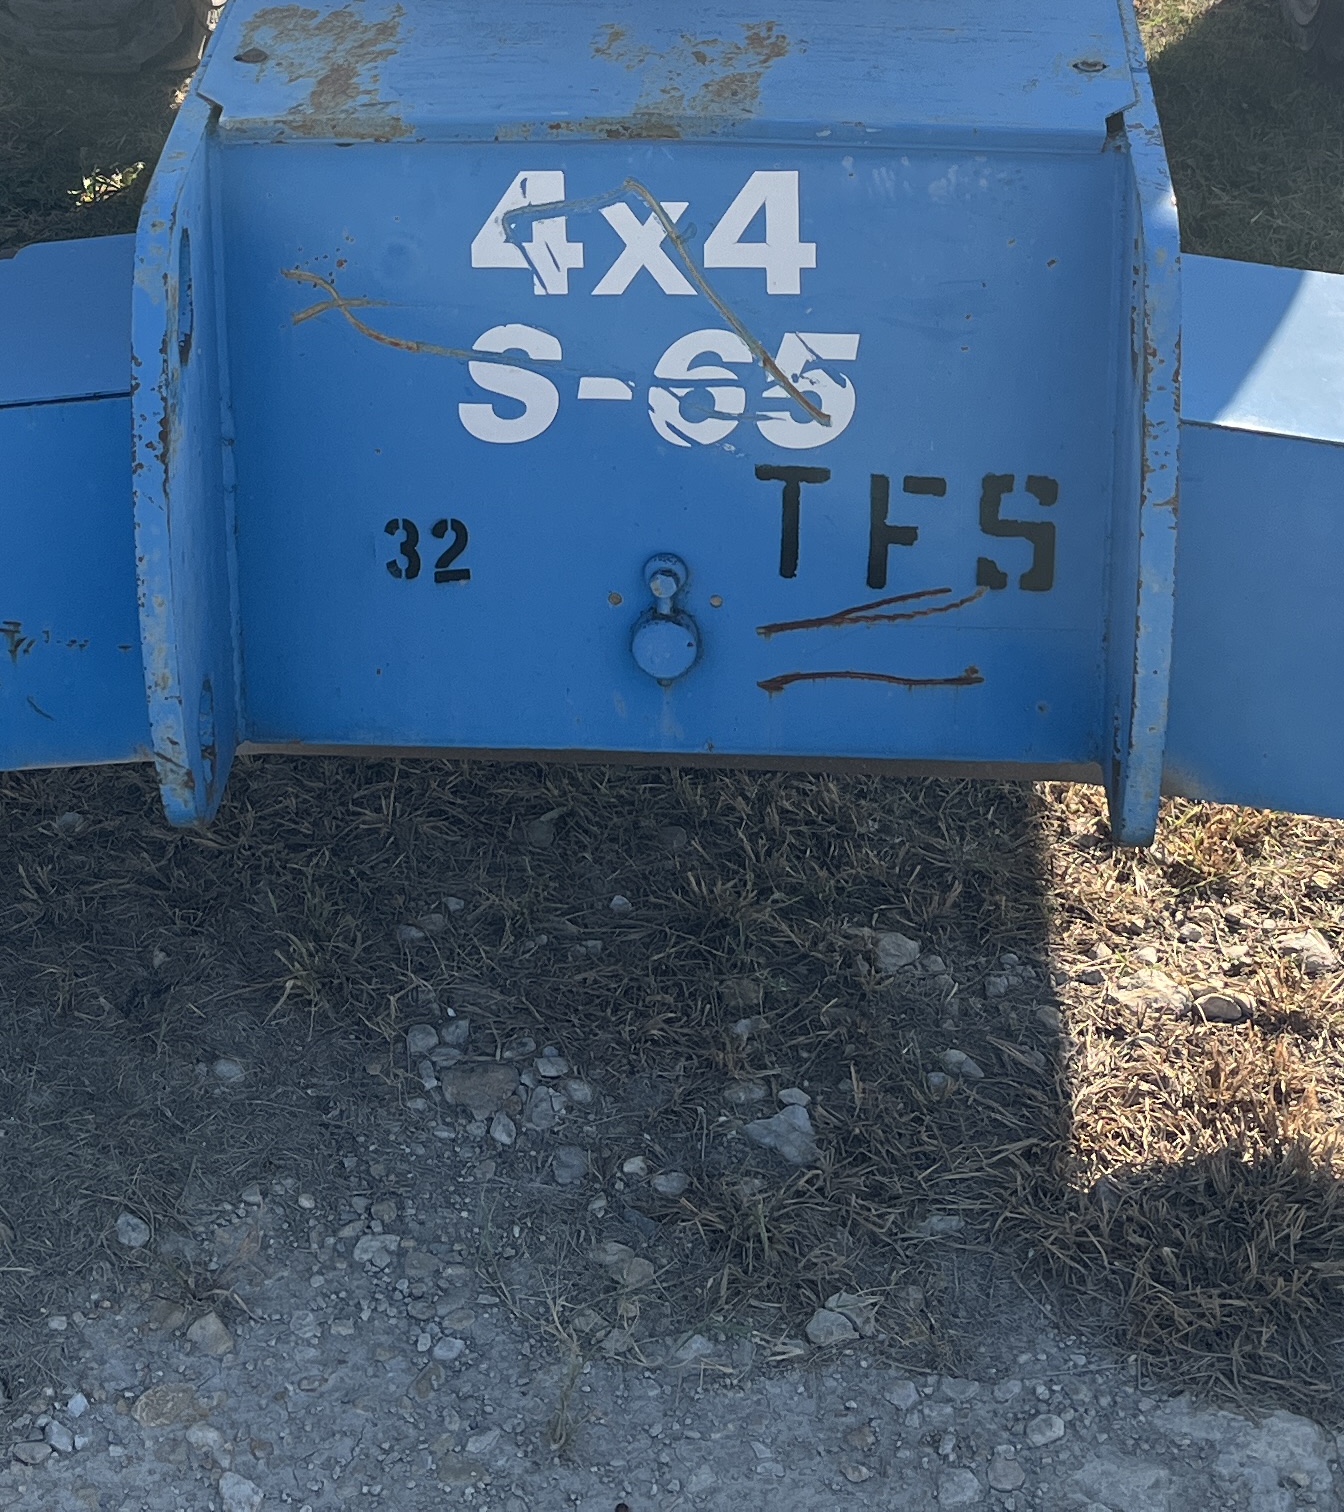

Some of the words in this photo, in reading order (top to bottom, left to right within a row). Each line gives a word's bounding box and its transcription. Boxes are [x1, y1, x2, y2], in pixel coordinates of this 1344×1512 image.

[470, 170, 817, 296] 4x4
[458, 323, 860, 450] S-65
[383, 517, 471, 584] 32
[754, 464, 1059, 595] TFS
